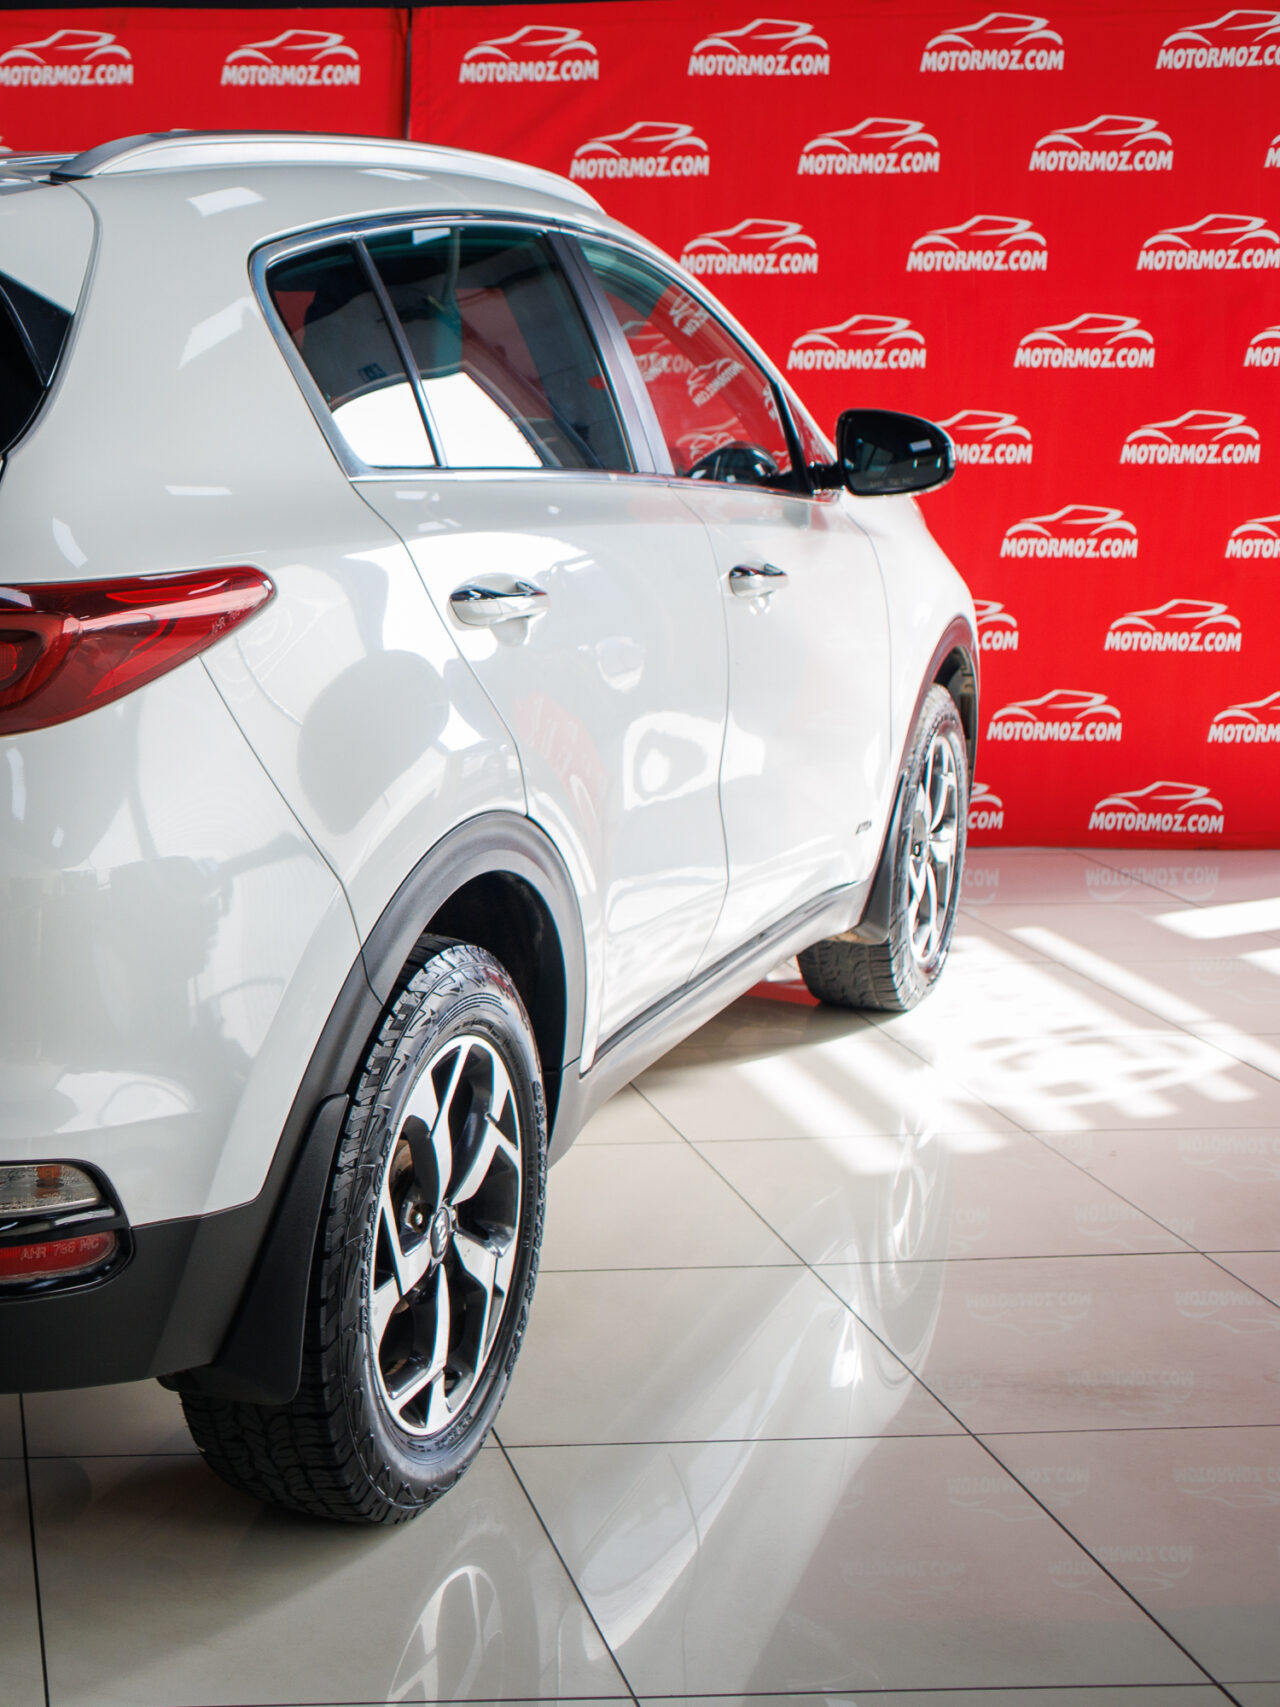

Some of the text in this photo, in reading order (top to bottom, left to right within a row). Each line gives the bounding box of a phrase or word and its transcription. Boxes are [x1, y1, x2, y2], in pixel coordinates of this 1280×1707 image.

[459, 60, 600, 83] MOTORMOZ.COM
[688, 54, 830, 76] MOTORMOZ.COM
[920, 49, 1065, 73] MOTORMOZ.COM
[221, 64, 361, 86] MOTORMOZ.COM
[569, 155, 710, 179] MOTORMOZ.COM
[797, 151, 940, 175] MOTORMOZ.COM
[1028, 149, 1174, 172] MOTORMOZ.COM
[680, 253, 819, 275] MOTORMOZ.COM
[906, 248, 1048, 272] MOTORMOZ.COM
[1136, 249, 1280, 271] MOTORMOZ.COM
[787, 348, 926, 371] MOTORMOZ.COM
[1014, 346, 1155, 369] MOTORMOZ.COM
[1120, 443, 1261, 465] MOTORMOZ.COM
[1000, 537, 1138, 559] MOTORMOZ.COM
[1104, 631, 1242, 652] MOTORMOZ.COM
[986, 721, 1122, 742] MOTORMOZ.COM
[1088, 811, 1224, 834] MOTORMOZ.COM
